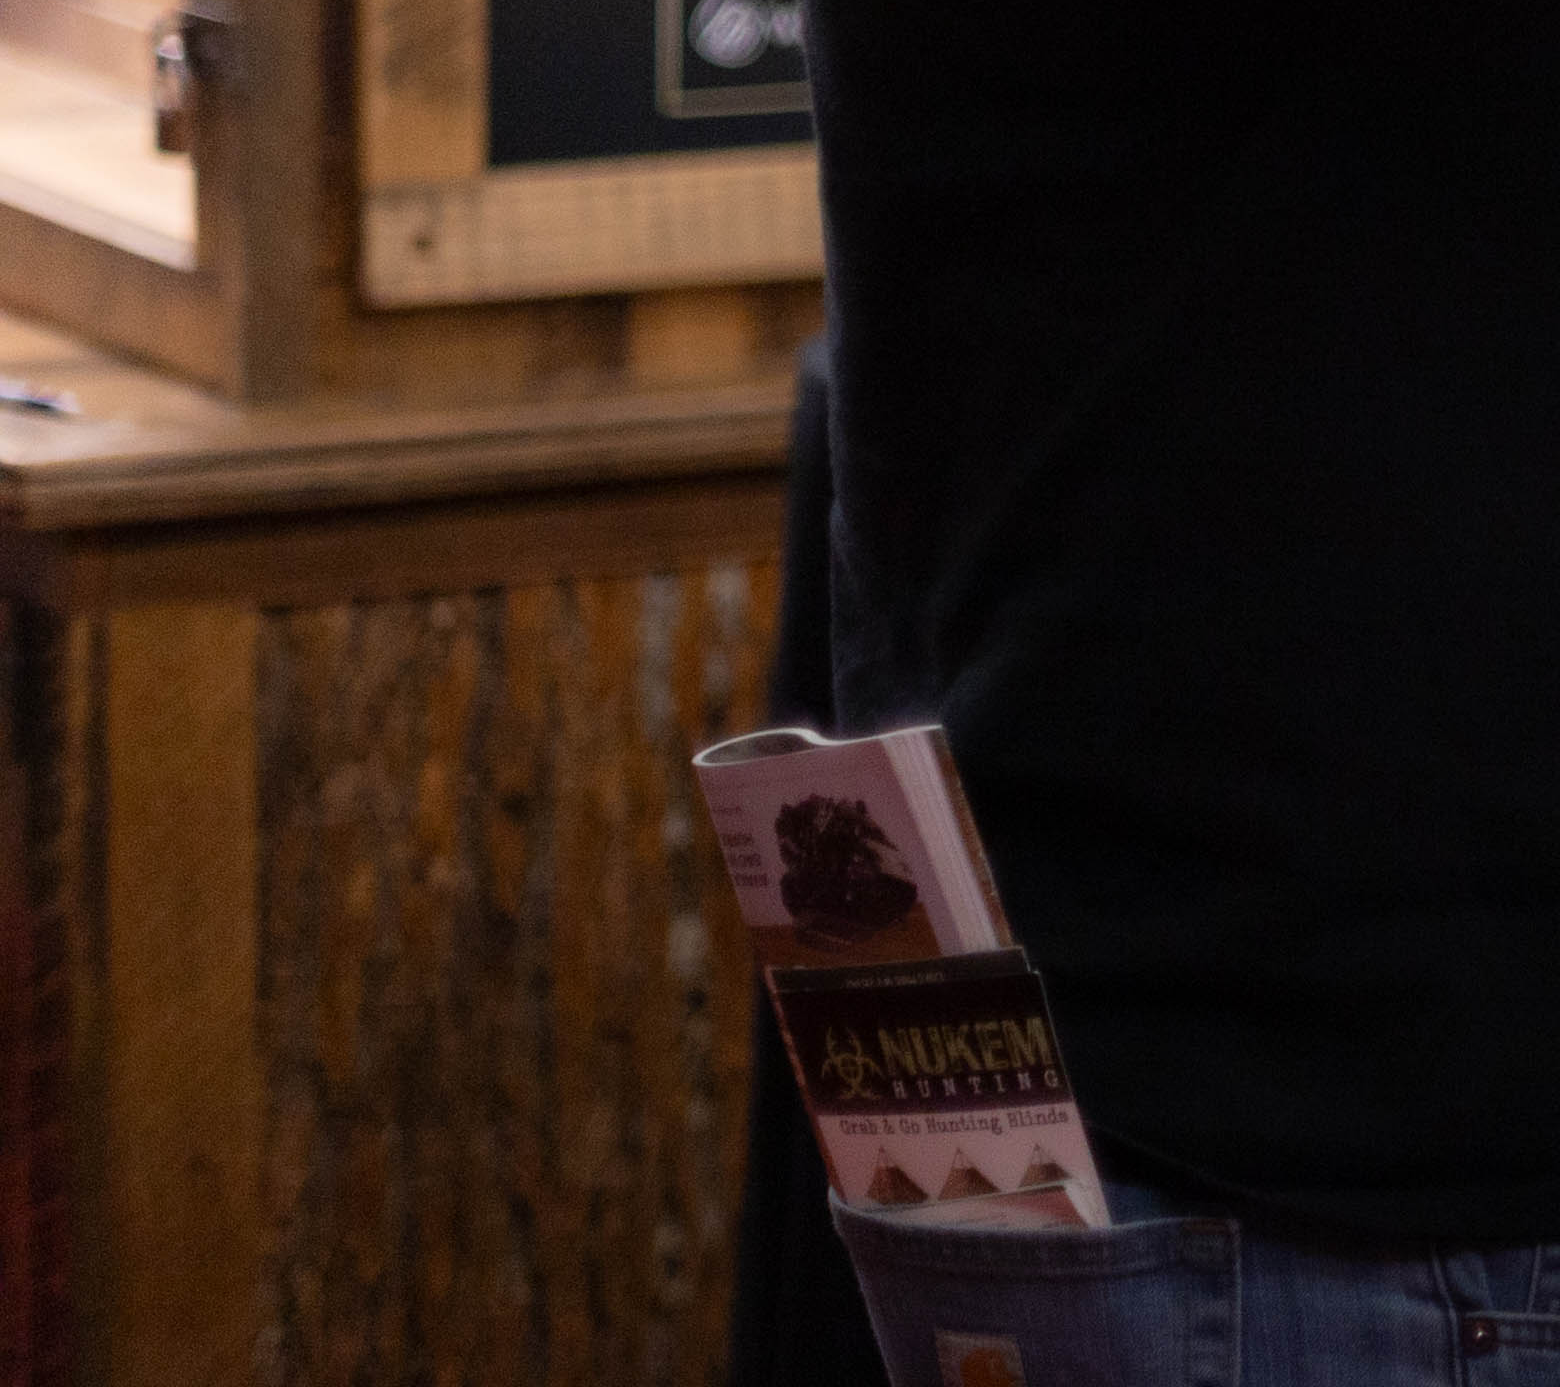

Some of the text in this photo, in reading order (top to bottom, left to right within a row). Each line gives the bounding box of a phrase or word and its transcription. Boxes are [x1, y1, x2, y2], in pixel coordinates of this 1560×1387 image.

[880, 1016, 1056, 1074] NUKEM
[892, 1070, 1060, 1100] HUNTING
[839, 1108, 1069, 1136] Grab & Go Hunting Blinds
